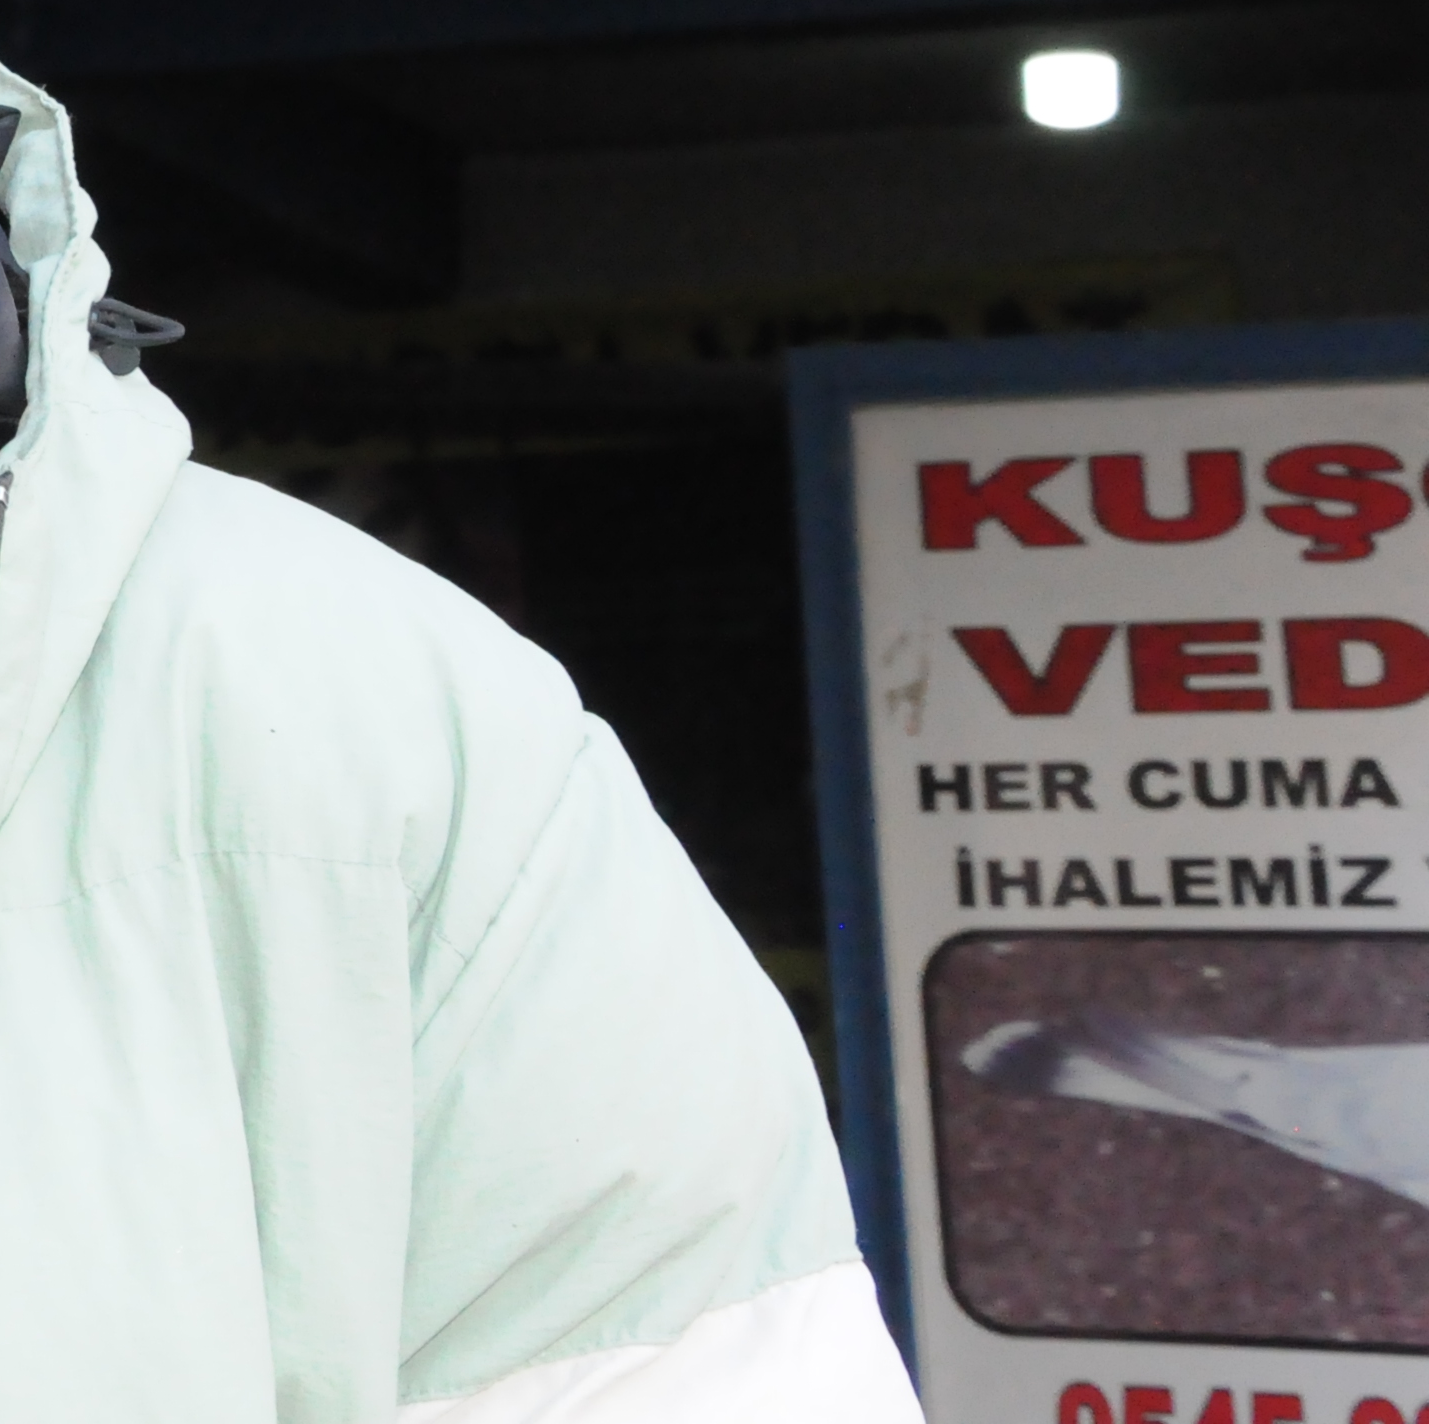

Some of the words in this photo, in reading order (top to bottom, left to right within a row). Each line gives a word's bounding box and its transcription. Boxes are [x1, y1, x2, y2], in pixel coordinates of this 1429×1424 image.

[917, 441, 1429, 565] KUŞ
[916, 761, 1096, 815] HER
[1126, 757, 1401, 812] CUMA
[955, 846, 1397, 910] İHALEMİZ
